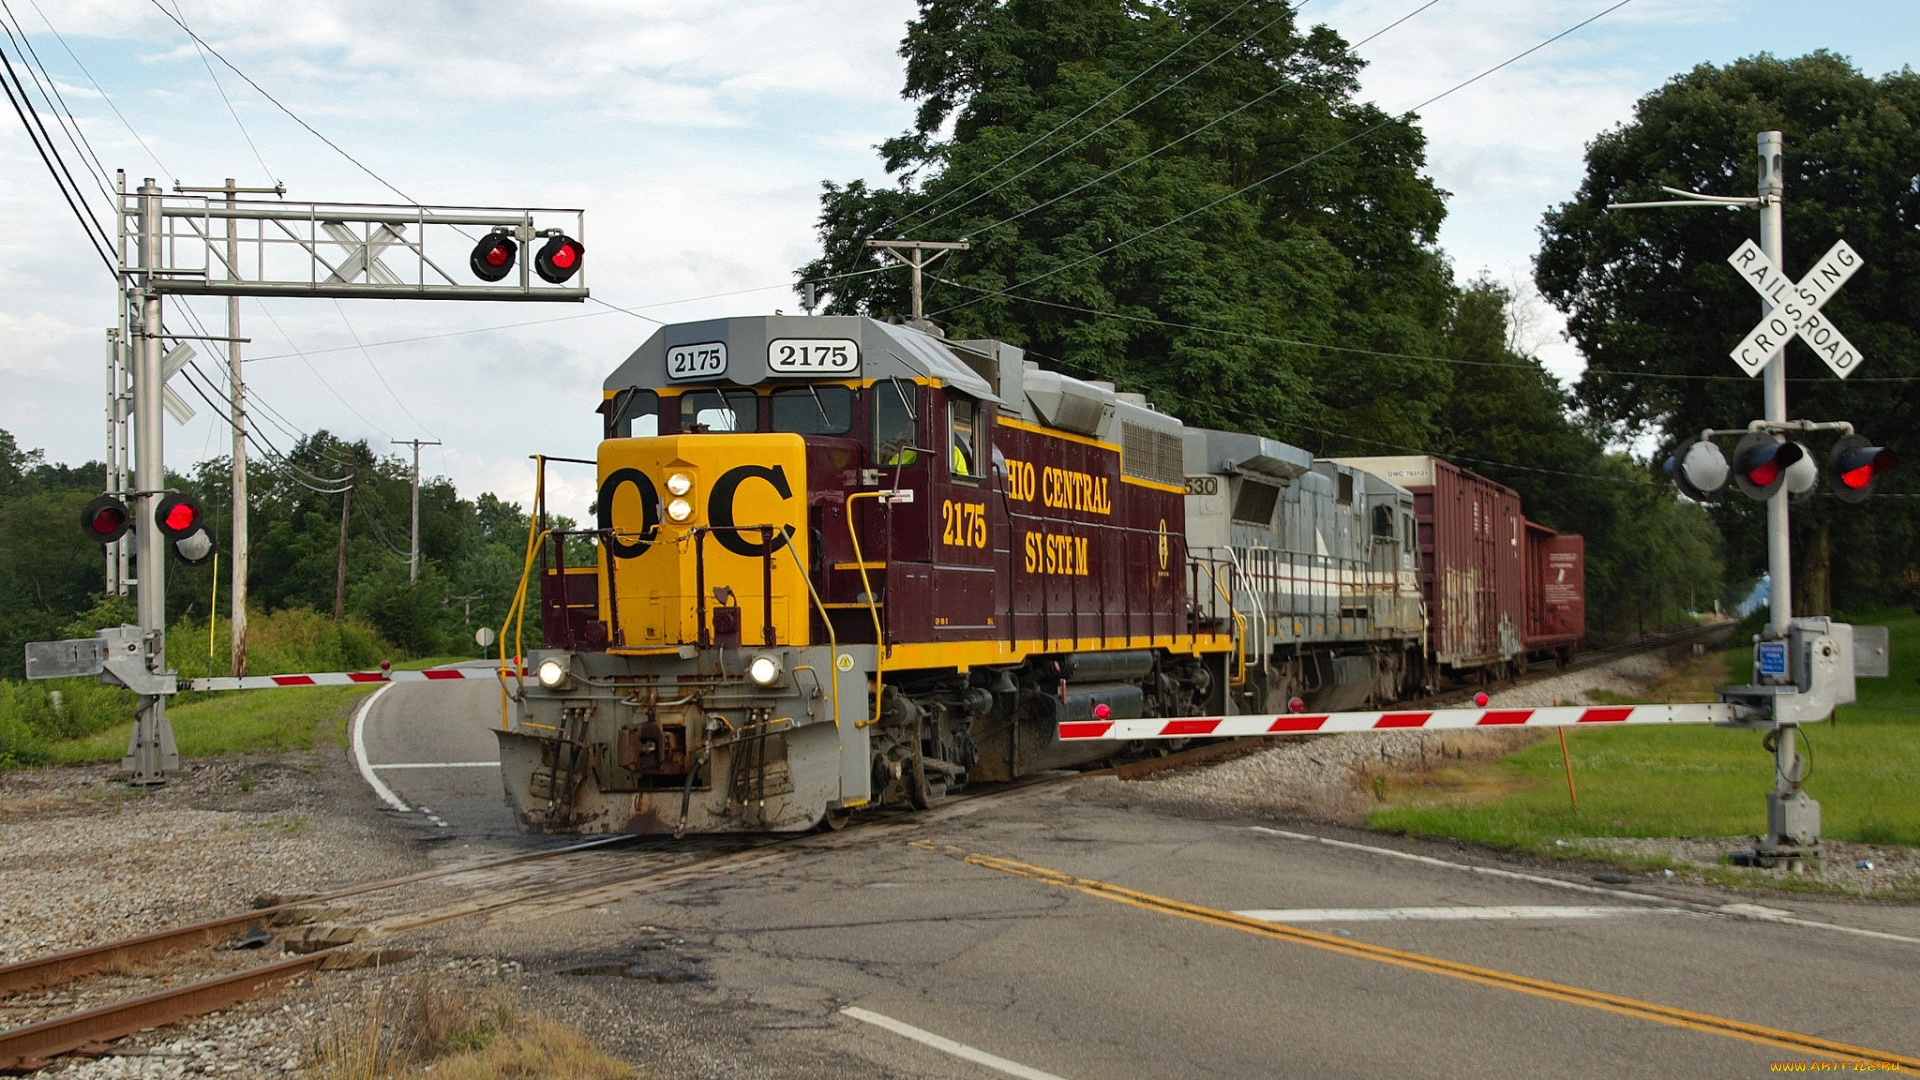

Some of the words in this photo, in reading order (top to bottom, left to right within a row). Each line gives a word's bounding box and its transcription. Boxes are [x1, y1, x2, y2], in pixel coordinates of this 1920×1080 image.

[1737, 248, 1785, 303] RAIL
[1801, 315, 1853, 369] ROAD
[1741, 249, 1854, 366] CROSSING
[674, 349, 721, 373] 2175
[779, 346, 848, 366] 2175
[1005, 459, 1035, 502] HIO
[1042, 466, 1111, 515] CENTRAL
[942, 499, 987, 549] 2175
